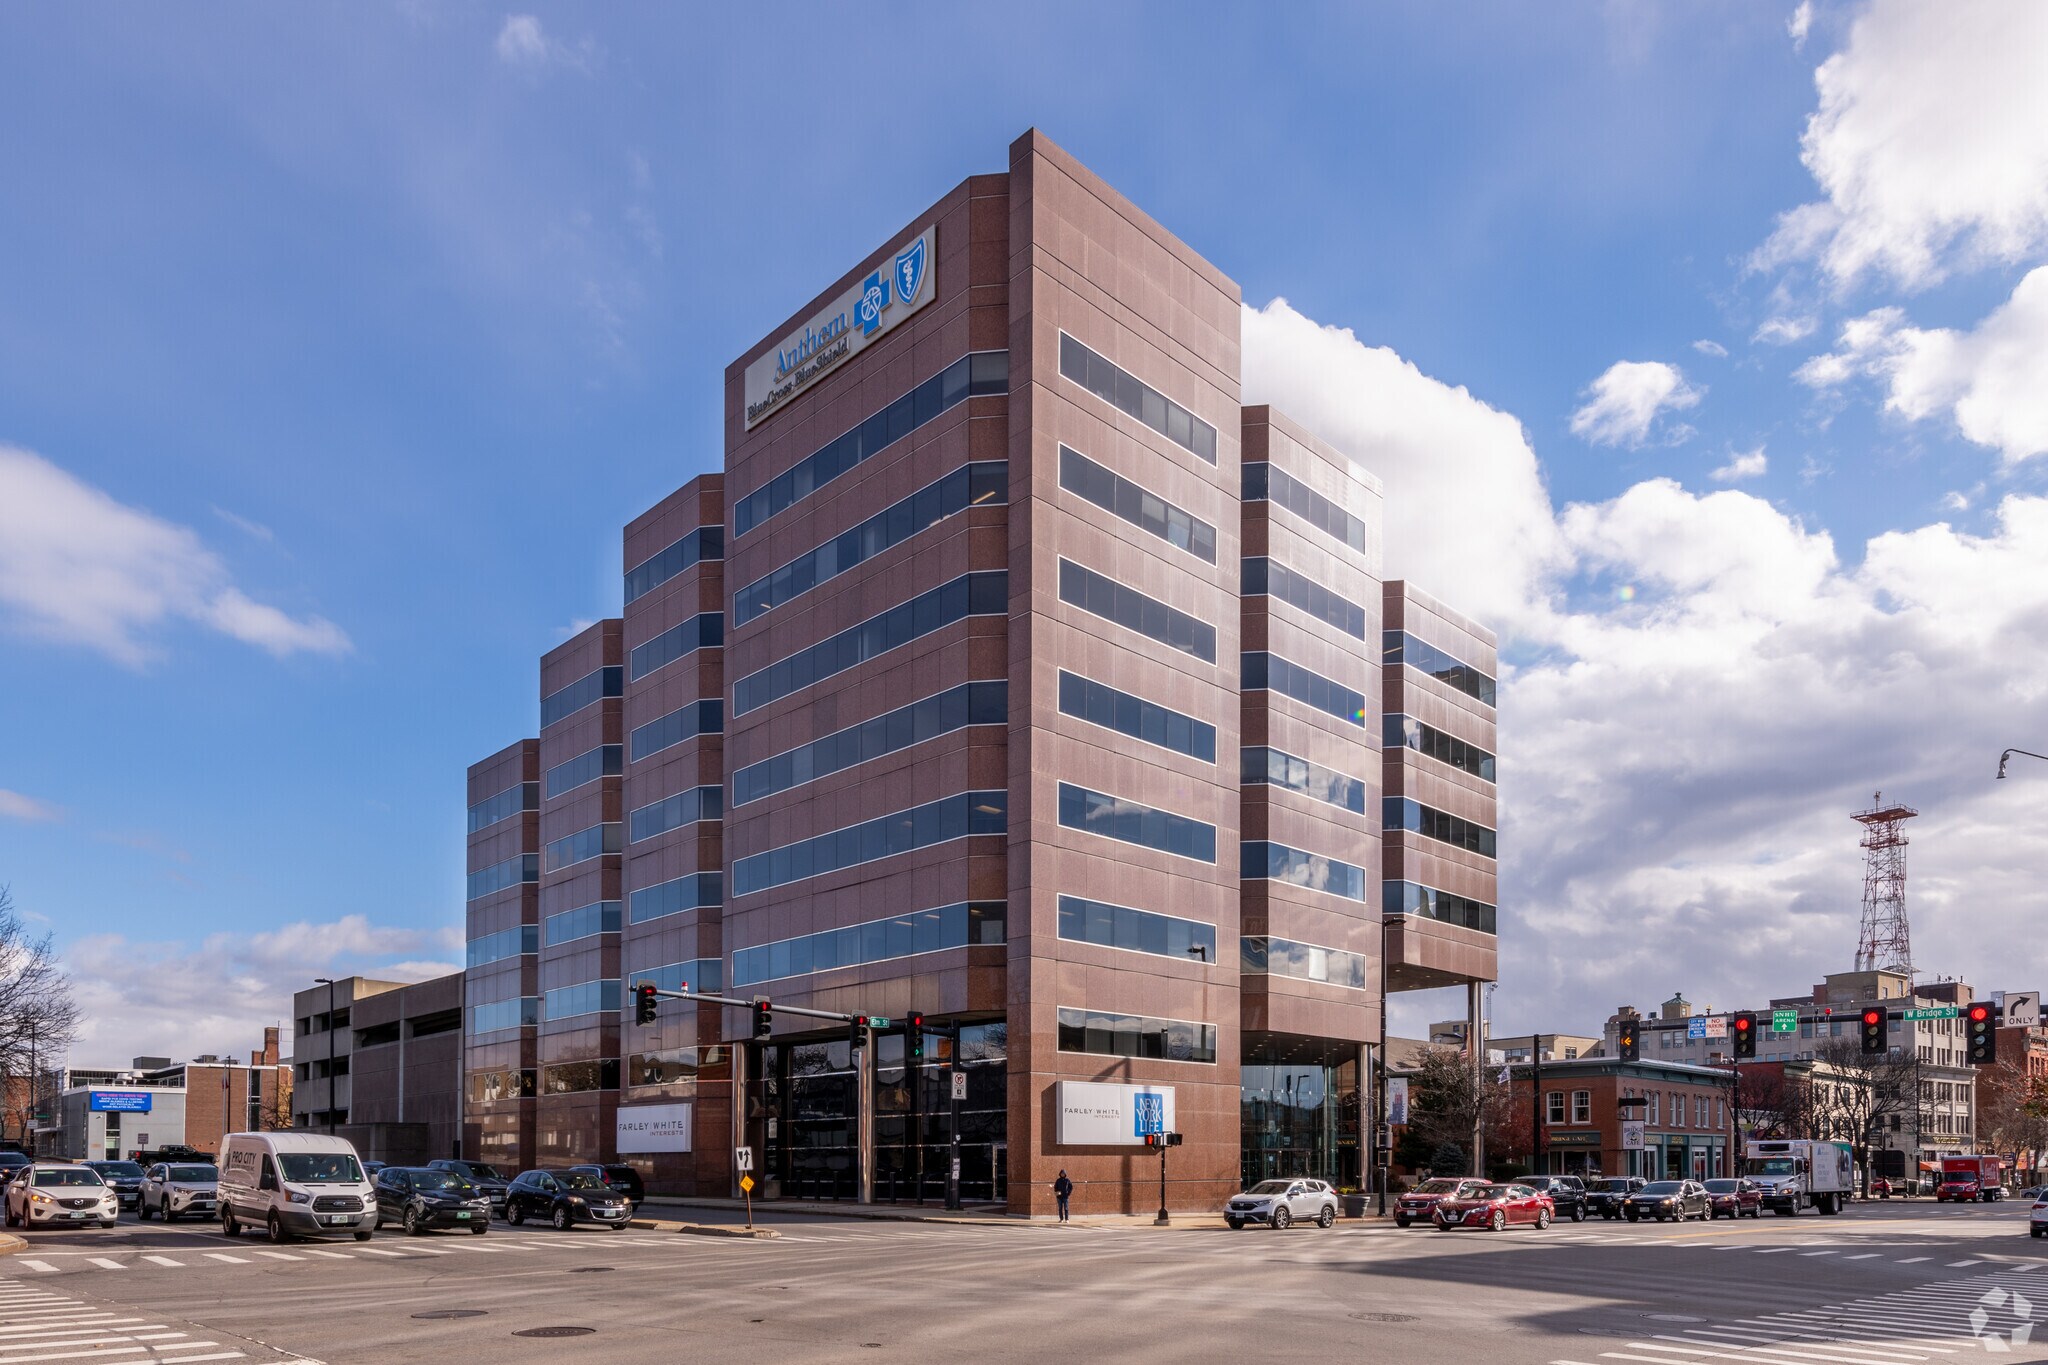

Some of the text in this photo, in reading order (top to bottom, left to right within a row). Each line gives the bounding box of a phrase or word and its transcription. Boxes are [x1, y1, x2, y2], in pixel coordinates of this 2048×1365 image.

[773, 313, 847, 383] Anthem
[747, 336, 849, 421] BlueCross BlueShield
[1907, 1007, 1955, 1019] W Bridge St
[871, 1018, 880, 1026] Elm
[2008, 1016, 2034, 1025] ONLY
[1139, 1097, 1160, 1110] NEW
[1064, 1107, 1093, 1115] FARLEY
[1136, 1108, 1162, 1121] YORK
[618, 1120, 684, 1132] FARLEY WHITE
[1139, 1119, 1160, 1133] LIFE
[231, 1150, 257, 1166] PRO CITY
